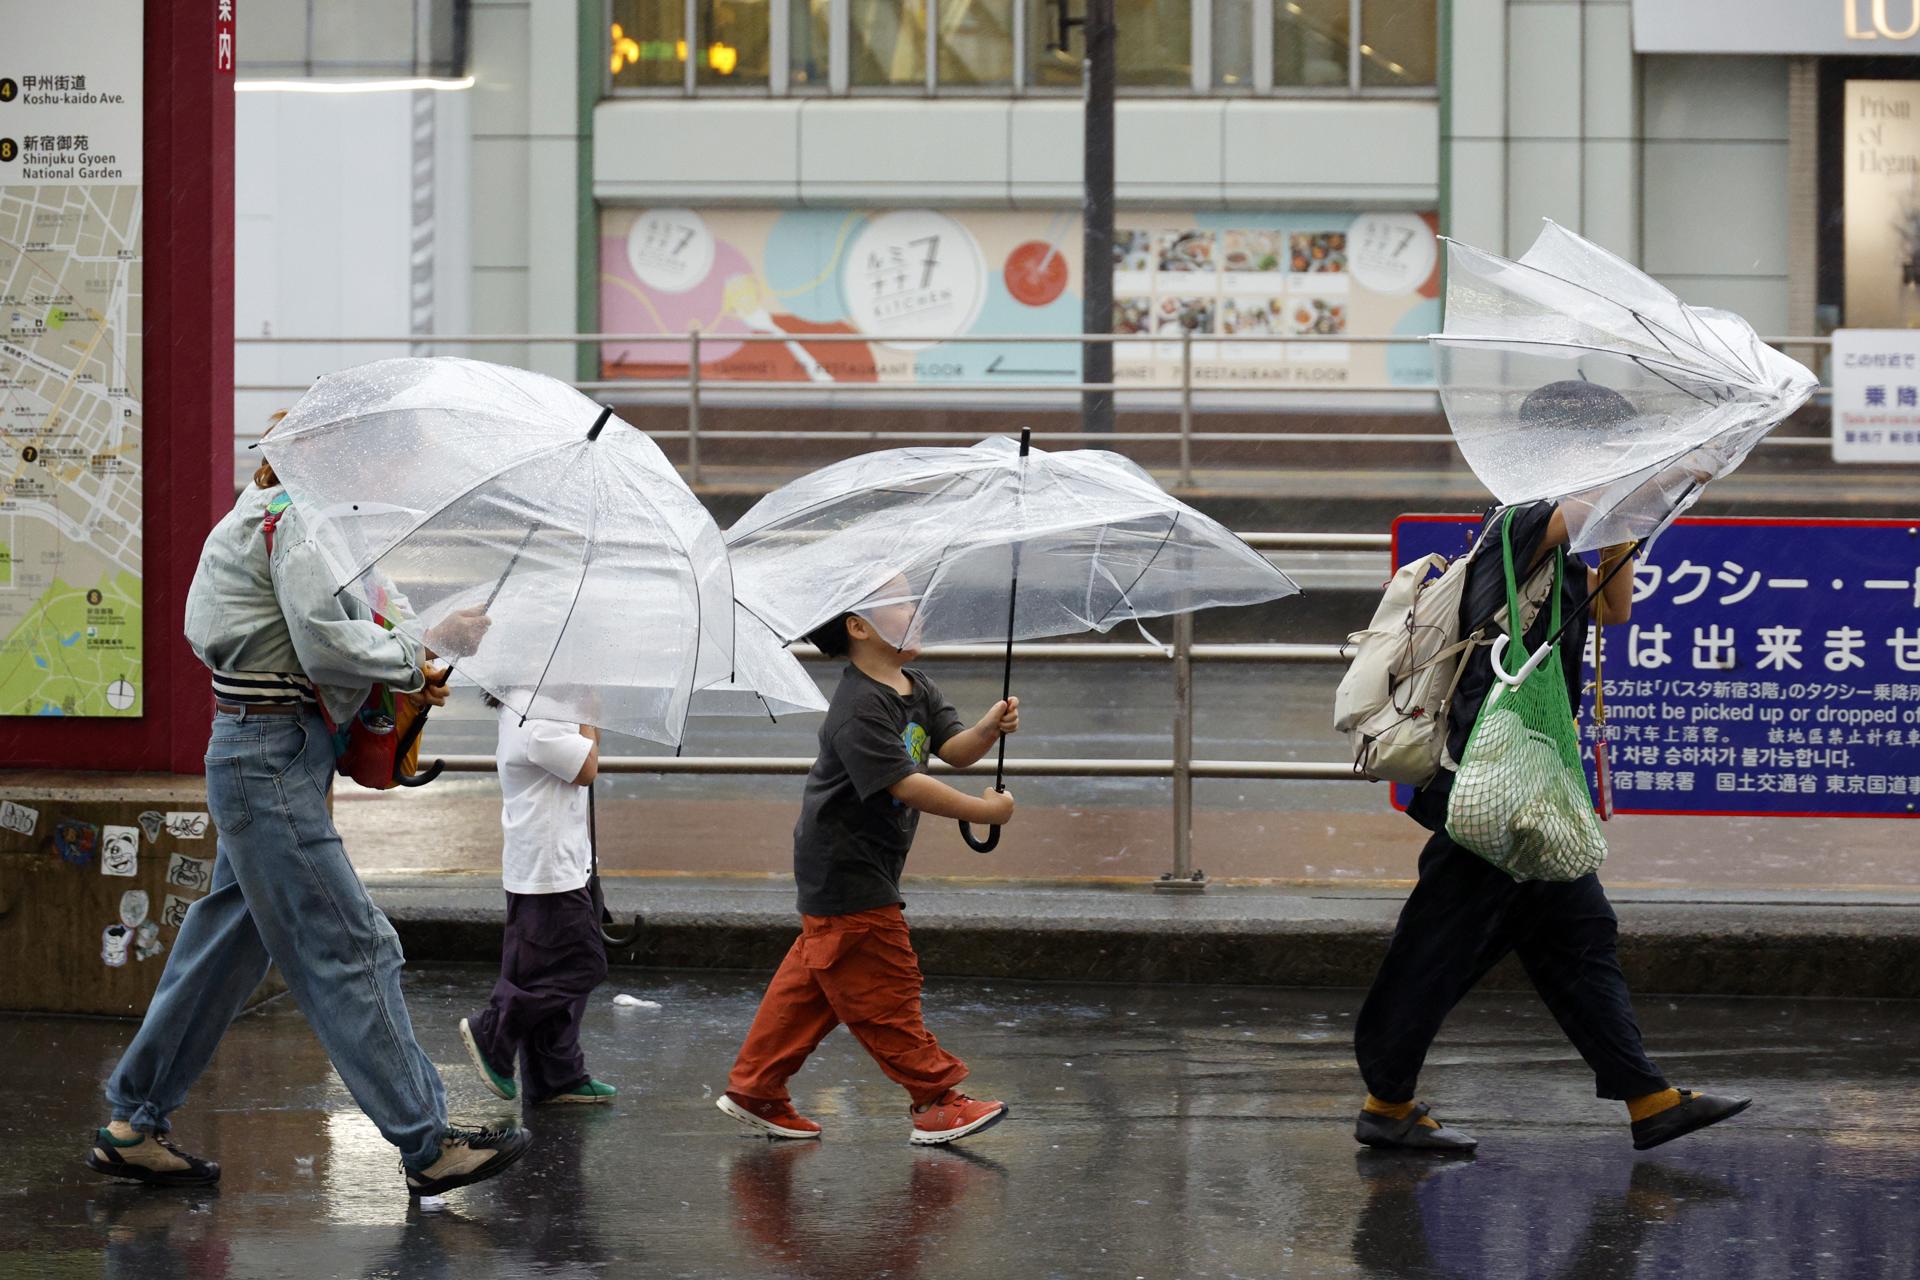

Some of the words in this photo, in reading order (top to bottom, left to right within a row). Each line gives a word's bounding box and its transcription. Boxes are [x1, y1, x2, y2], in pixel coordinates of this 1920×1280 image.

[1, 83, 10, 97] 4
[22, 75, 86, 91] 甲州街道
[23, 93, 97, 104] Koshu-kaido
[100, 94, 124, 104] Ave.
[2, 143, 11, 158] 8
[23, 136, 89, 151] 新宿御苑
[23, 154, 75, 166] Shinjuku
[78, 154, 116, 166] Gyoen
[23, 168, 74, 179] National
[79, 167, 122, 179] Garden
[1632, 559, 1920, 608] タクシー・一
[1662, 702, 1686, 719] be
[1691, 703, 1754, 723] picked
[1759, 706, 1784, 725] up
[1790, 707, 1811, 721] or
[1816, 704, 1897, 726] dropped
[1578, 725, 1730, 743] 车和汽车上落客。
[1623, 745, 1660, 765] 차량
[1664, 746, 1736, 767] 승하차가
[1741, 747, 1855, 769] 불가능합니다.
[1716, 772, 1818, 793] 国土交通省
